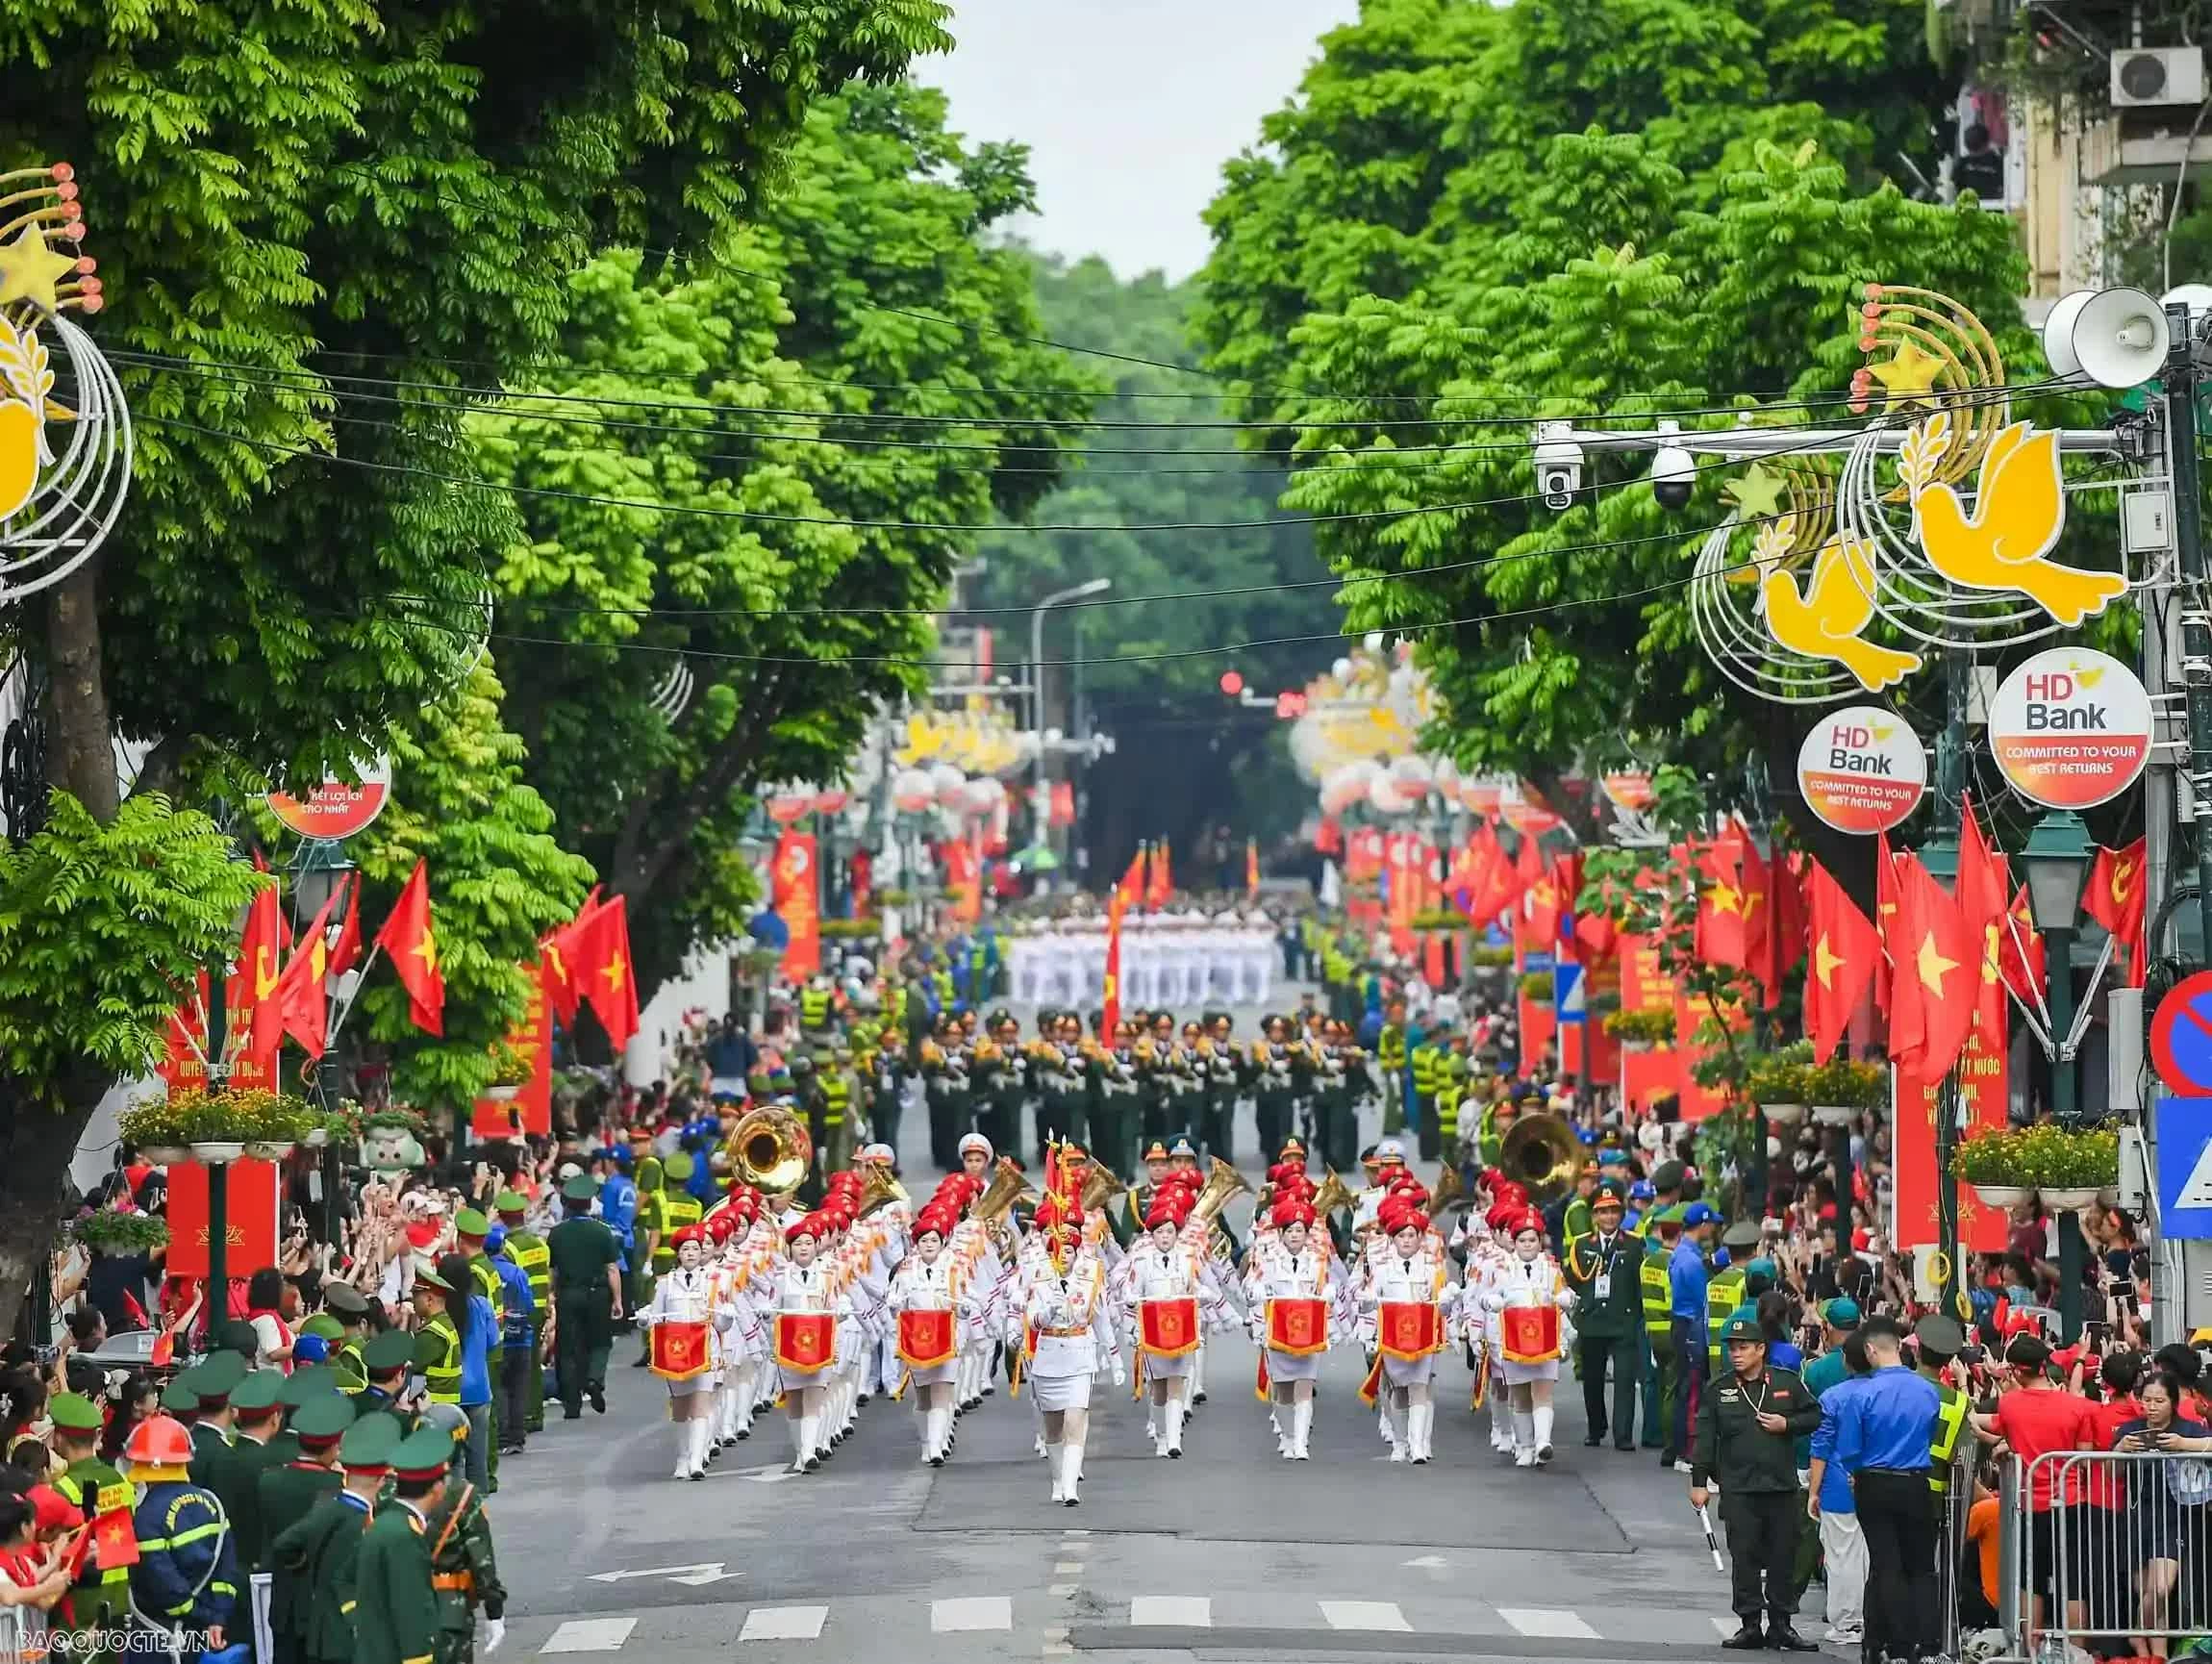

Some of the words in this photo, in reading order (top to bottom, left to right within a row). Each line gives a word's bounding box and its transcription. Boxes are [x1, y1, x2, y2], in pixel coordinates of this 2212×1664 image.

[2026, 674, 2074, 700] HD
[2026, 703, 2107, 730] Bank
[1832, 725, 1870, 748] HD
[1829, 748, 1893, 775] Bank
[2006, 746, 2079, 759] COMMITTED
[2081, 746, 2100, 757] TO
[2101, 745, 2137, 757] YOUR
[2028, 763, 2059, 774] BEST
[2060, 762, 2114, 774] RETURNS
[1810, 780, 1868, 794] COMMITTED
[1869, 787, 1883, 797] TO
[1884, 789, 1912, 800] YOUR
[1850, 797, 1893, 811] RETURNS
[1974, 1054, 2000, 1076] NƯỚC
